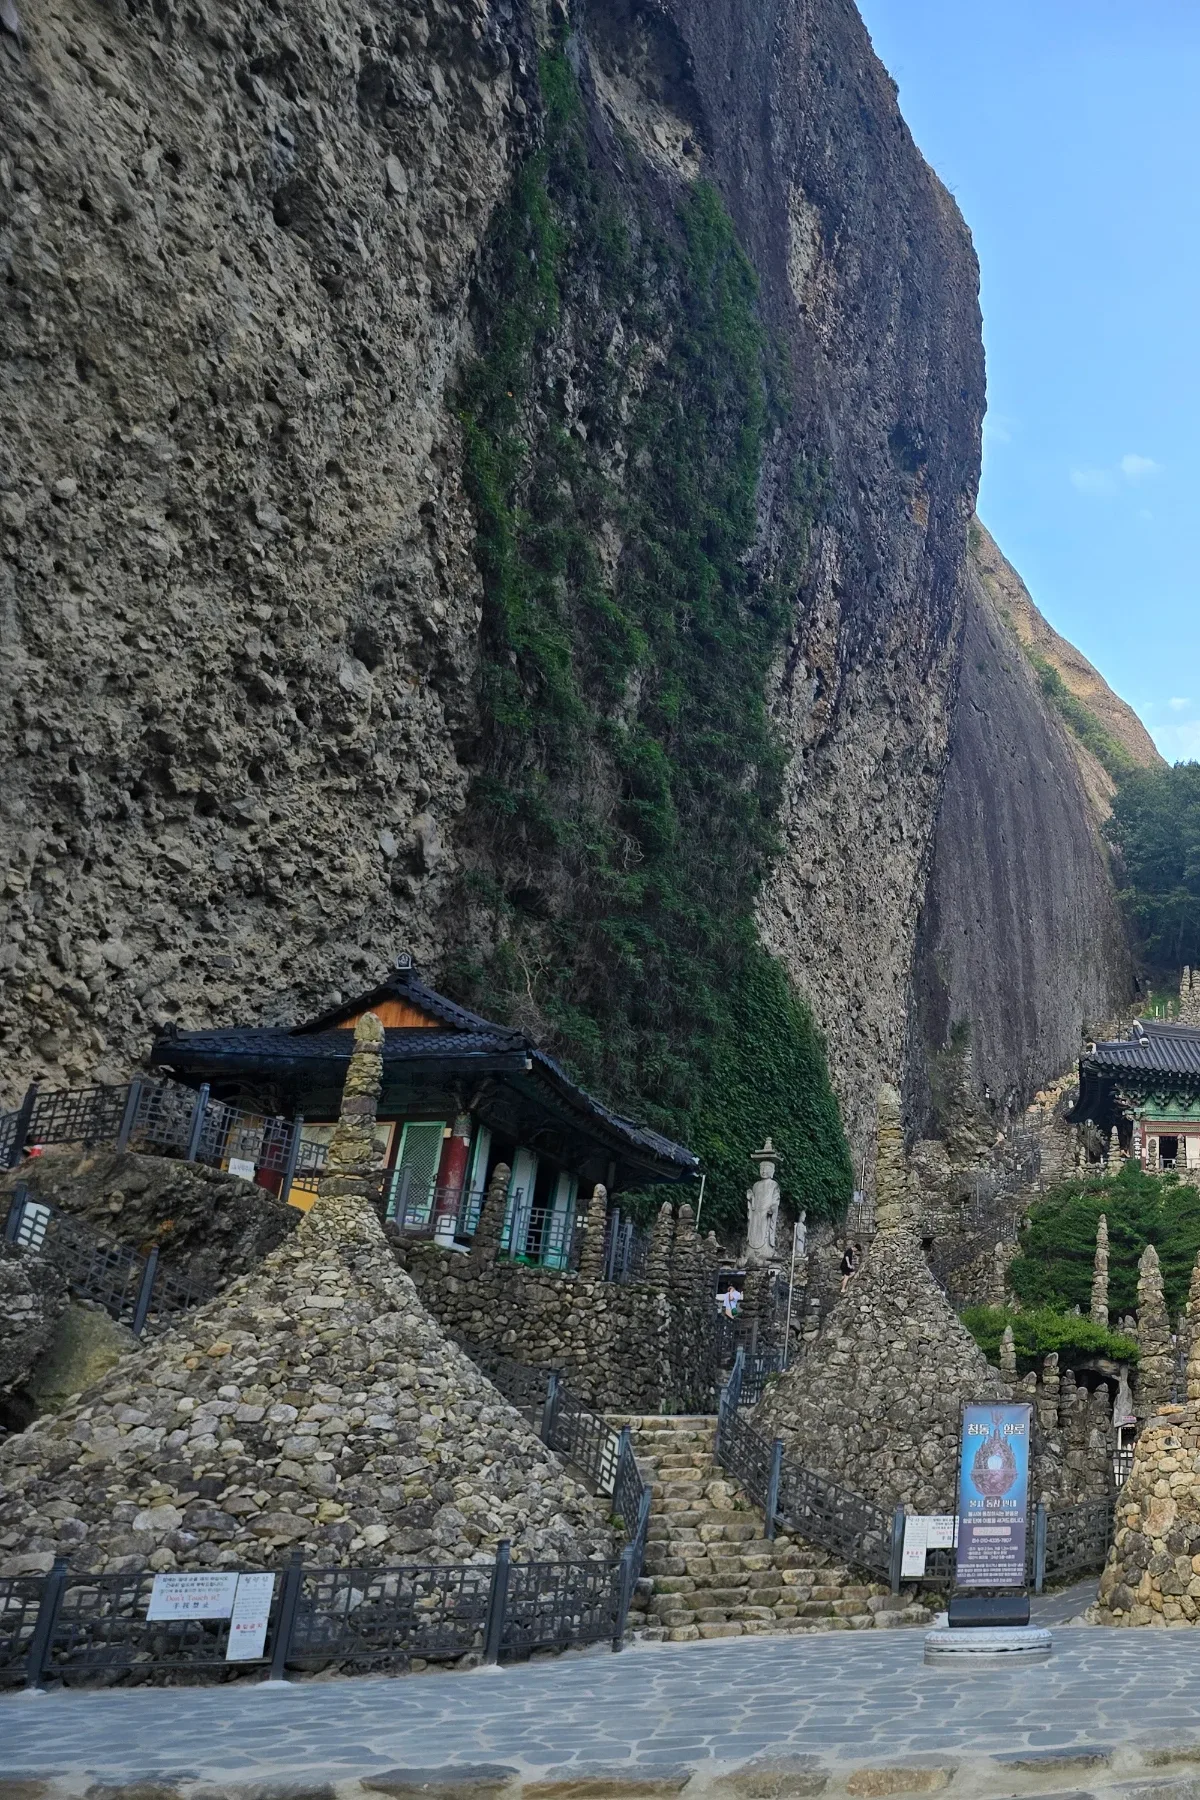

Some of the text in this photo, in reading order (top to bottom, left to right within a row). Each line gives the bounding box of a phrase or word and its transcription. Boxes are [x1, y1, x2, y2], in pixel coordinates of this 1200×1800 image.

[967, 1423, 1025, 1436] 청동 향로
[969, 1499, 984, 1508] 불사
[986, 1499, 1000, 1508] 동참
[166, 1594, 185, 1602] Don't
